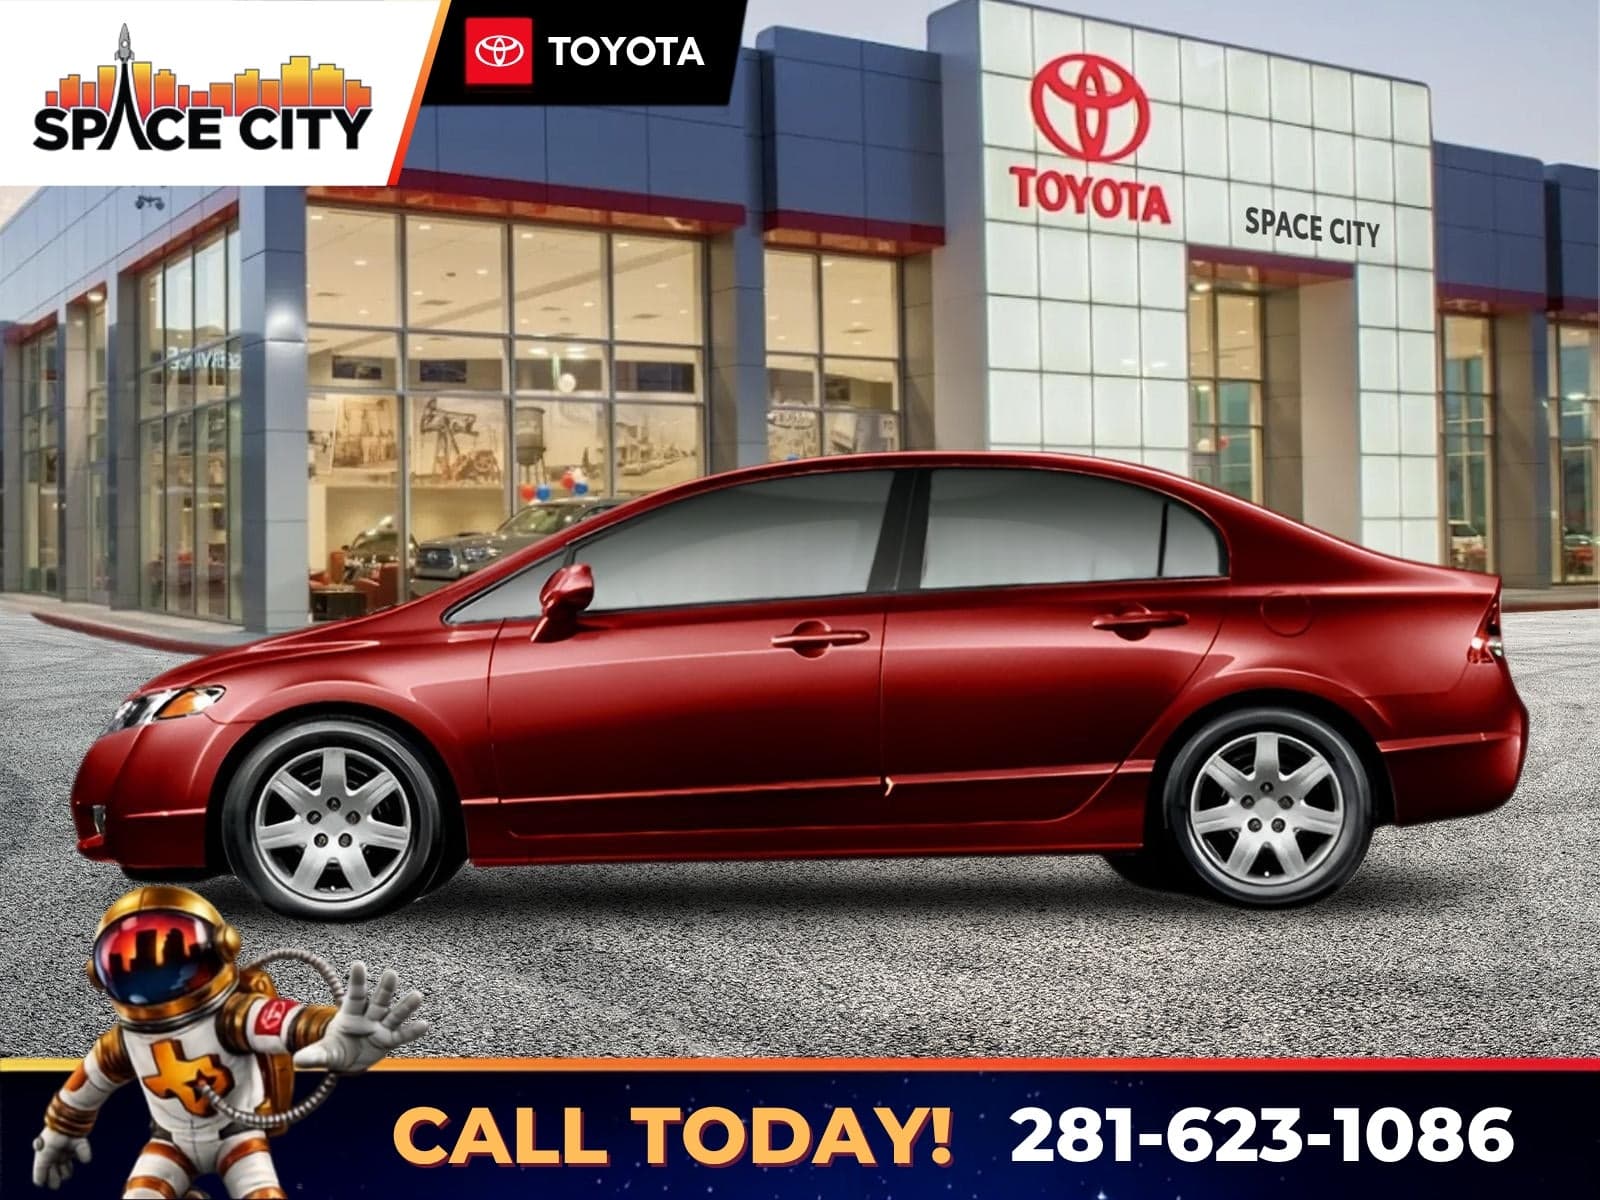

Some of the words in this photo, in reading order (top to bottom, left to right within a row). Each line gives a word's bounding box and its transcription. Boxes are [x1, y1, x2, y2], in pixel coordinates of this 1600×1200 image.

[1009, 165, 1171, 224] TOYOTA
[1244, 206, 1322, 242] SPACE
[1329, 217, 1381, 248] CITY
